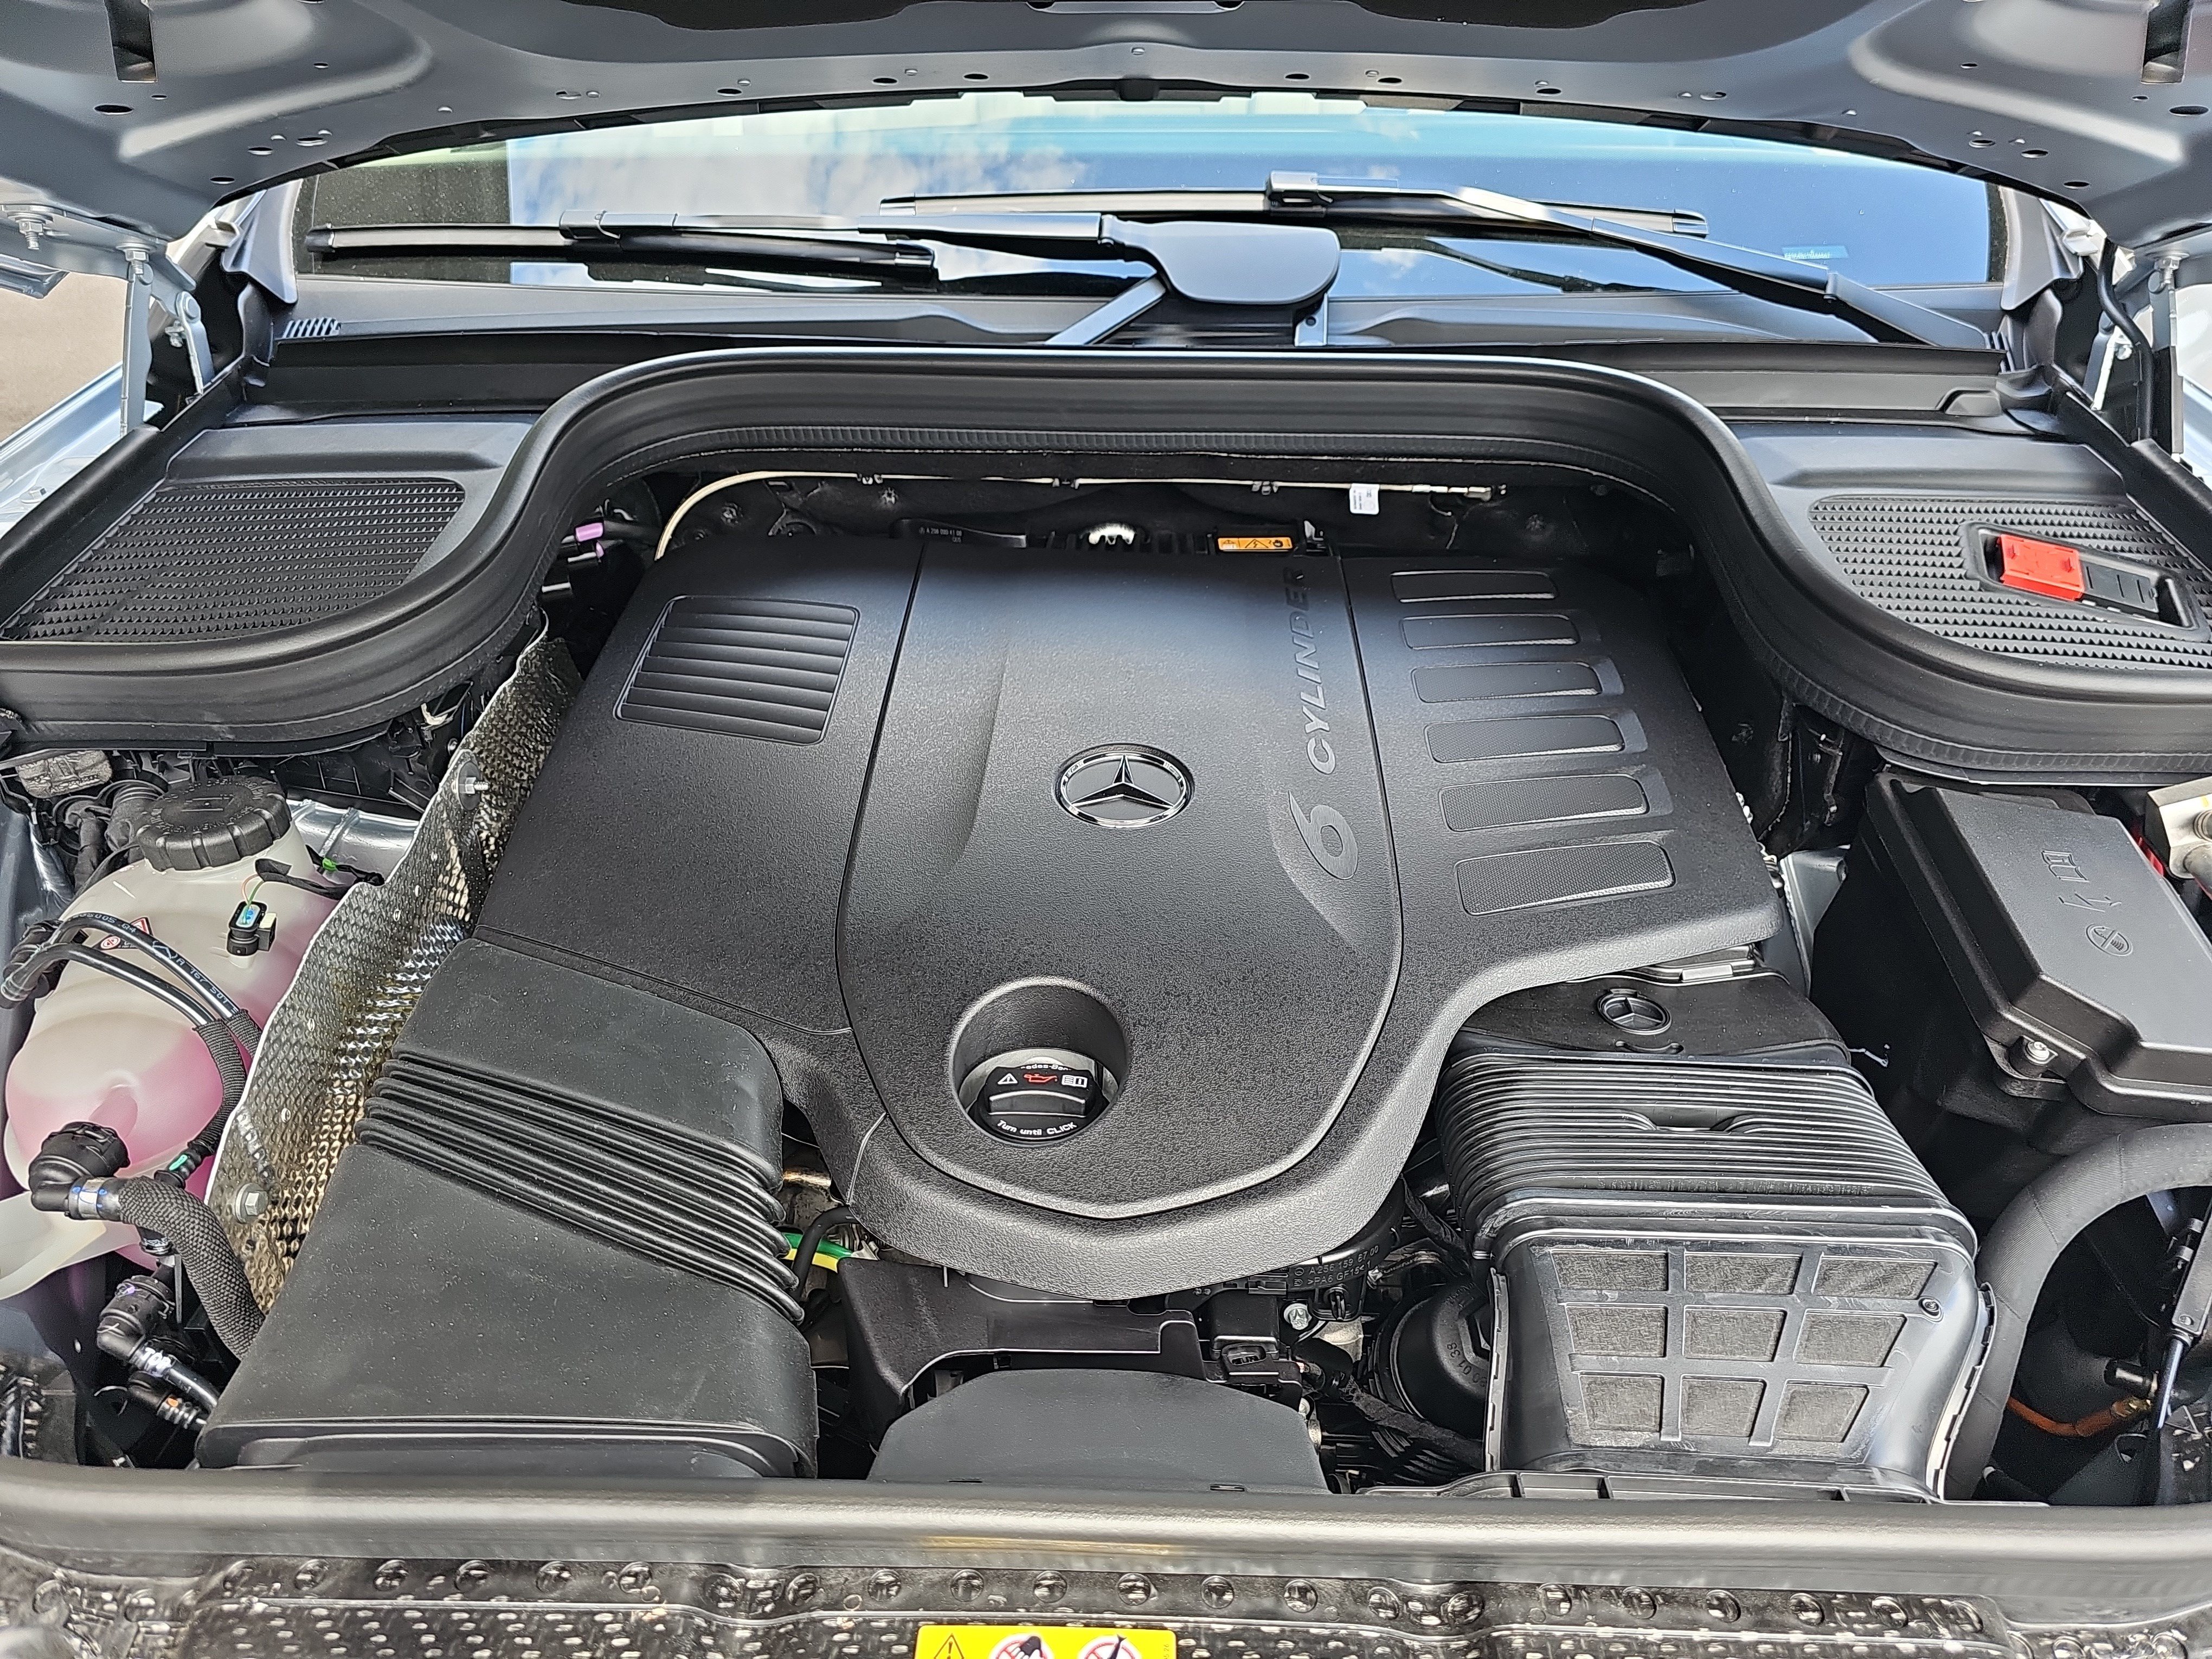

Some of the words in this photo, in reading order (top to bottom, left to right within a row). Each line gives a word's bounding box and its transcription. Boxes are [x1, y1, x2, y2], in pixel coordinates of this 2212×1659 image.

[1282, 566, 1336, 775] CYLINDER
[1288, 790, 1359, 880] 6
[997, 1120, 1017, 1133] Turn
[1046, 1122, 1077, 1135] CLICK
[1338, 1258, 1354, 1269] 159
[1369, 1245, 1379, 1256] 00
[140, 1347, 172, 1370] TOP
[1446, 1342, 1461, 1358] 38
